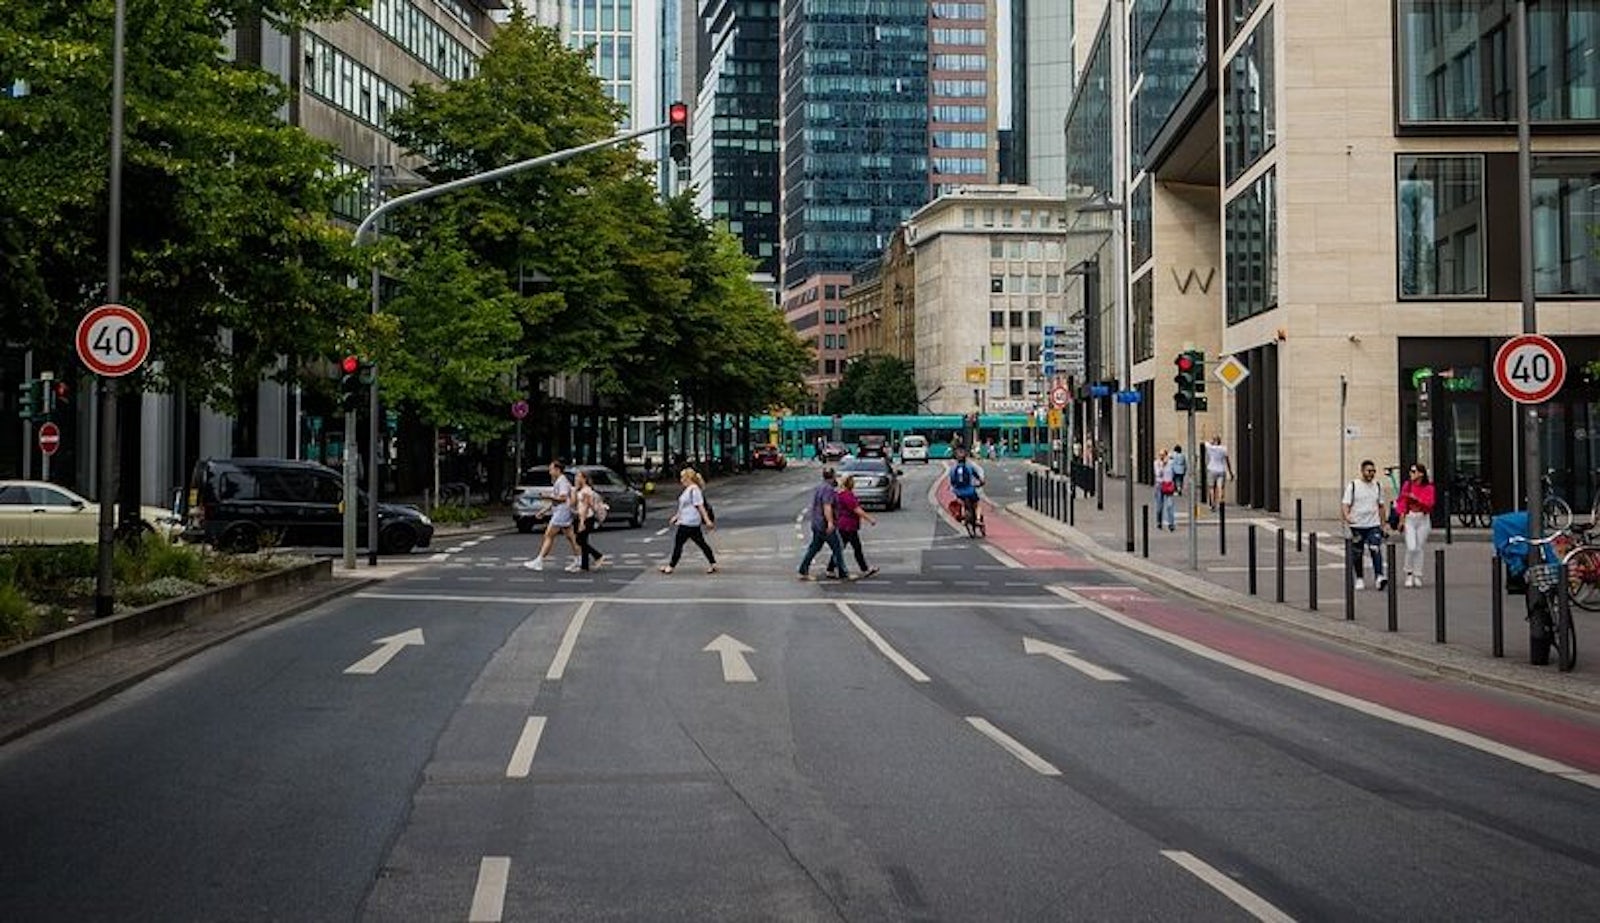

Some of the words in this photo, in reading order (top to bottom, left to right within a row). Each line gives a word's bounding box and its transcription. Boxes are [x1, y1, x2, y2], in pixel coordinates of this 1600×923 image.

[1171, 267, 1216, 294] W
[93, 326, 134, 356] 40
[1511, 354, 1549, 383] 40
